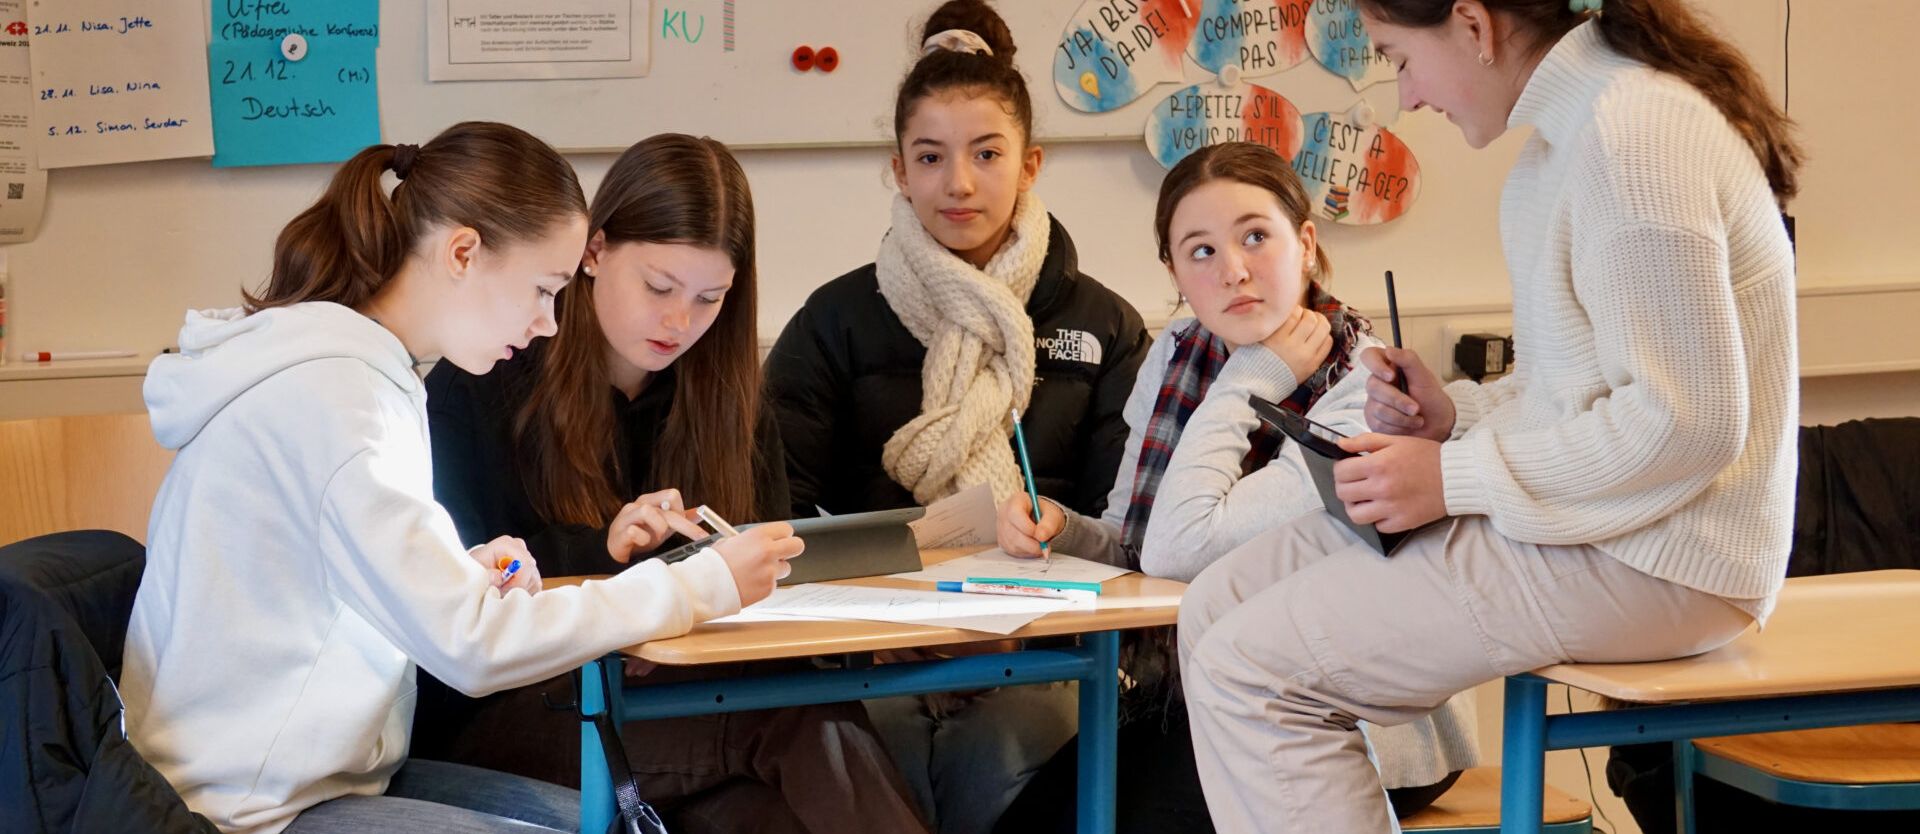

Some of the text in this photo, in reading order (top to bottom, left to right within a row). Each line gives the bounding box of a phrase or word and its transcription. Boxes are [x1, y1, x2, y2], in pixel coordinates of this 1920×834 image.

[662, 8, 705, 44] KU
[1099, 0, 1142, 32] BES
[1240, 41, 1277, 71] PAS
[126, 82, 161, 92] Nina
[241, 96, 336, 121] Deutsch
[1253, 95, 1280, 119] S'IL
[1172, 126, 1219, 150] VOUS
[1313, 117, 1364, 154] C'EST
[1345, 162, 1409, 204] PAGE?
[1036, 337, 1081, 351] NORTH
[1056, 328, 1082, 340] THE
[1049, 349, 1081, 361] FACE
